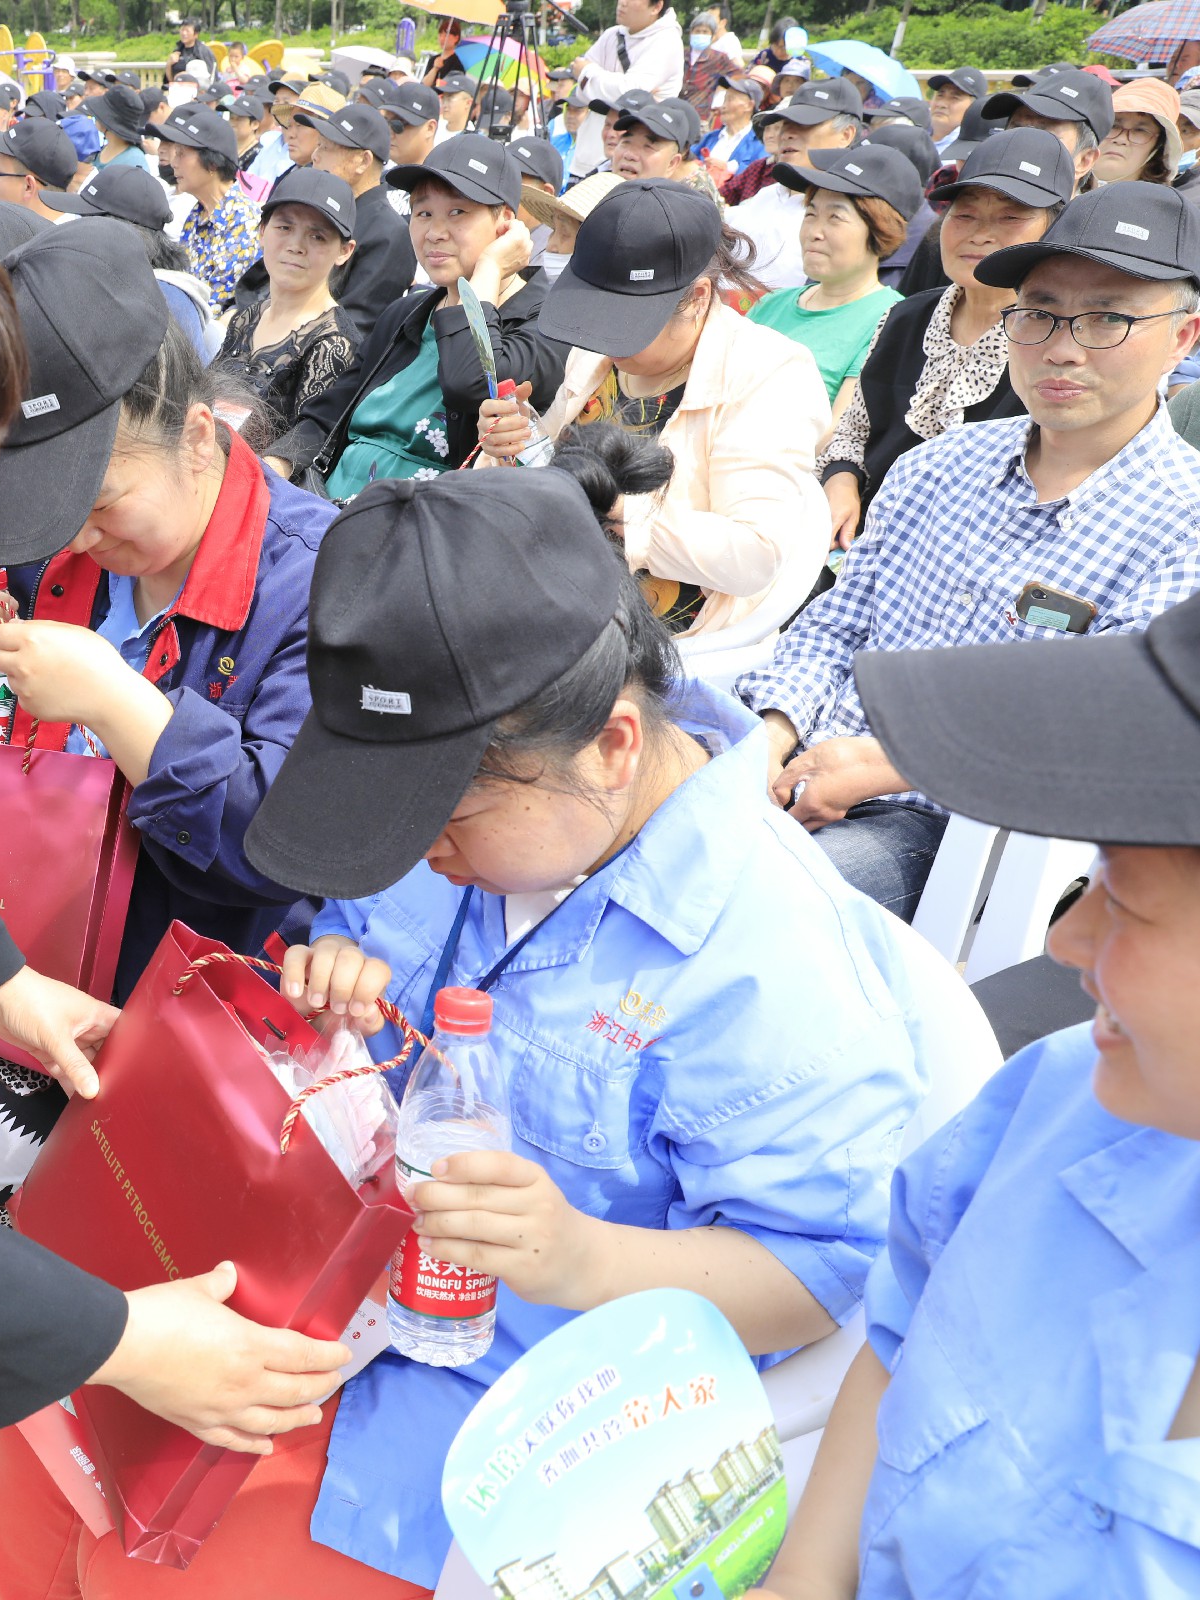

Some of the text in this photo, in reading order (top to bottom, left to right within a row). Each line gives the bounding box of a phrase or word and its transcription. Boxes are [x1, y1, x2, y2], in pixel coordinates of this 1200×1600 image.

[368, 694, 401, 705] SPORT
[585, 1010, 664, 1052] 浙江中
[90, 1119, 183, 1282] SATELLITE PETROCHEMIC
[417, 1273, 462, 1291] NONGFU
[416, 1286, 456, 1302] 饮用天然水
